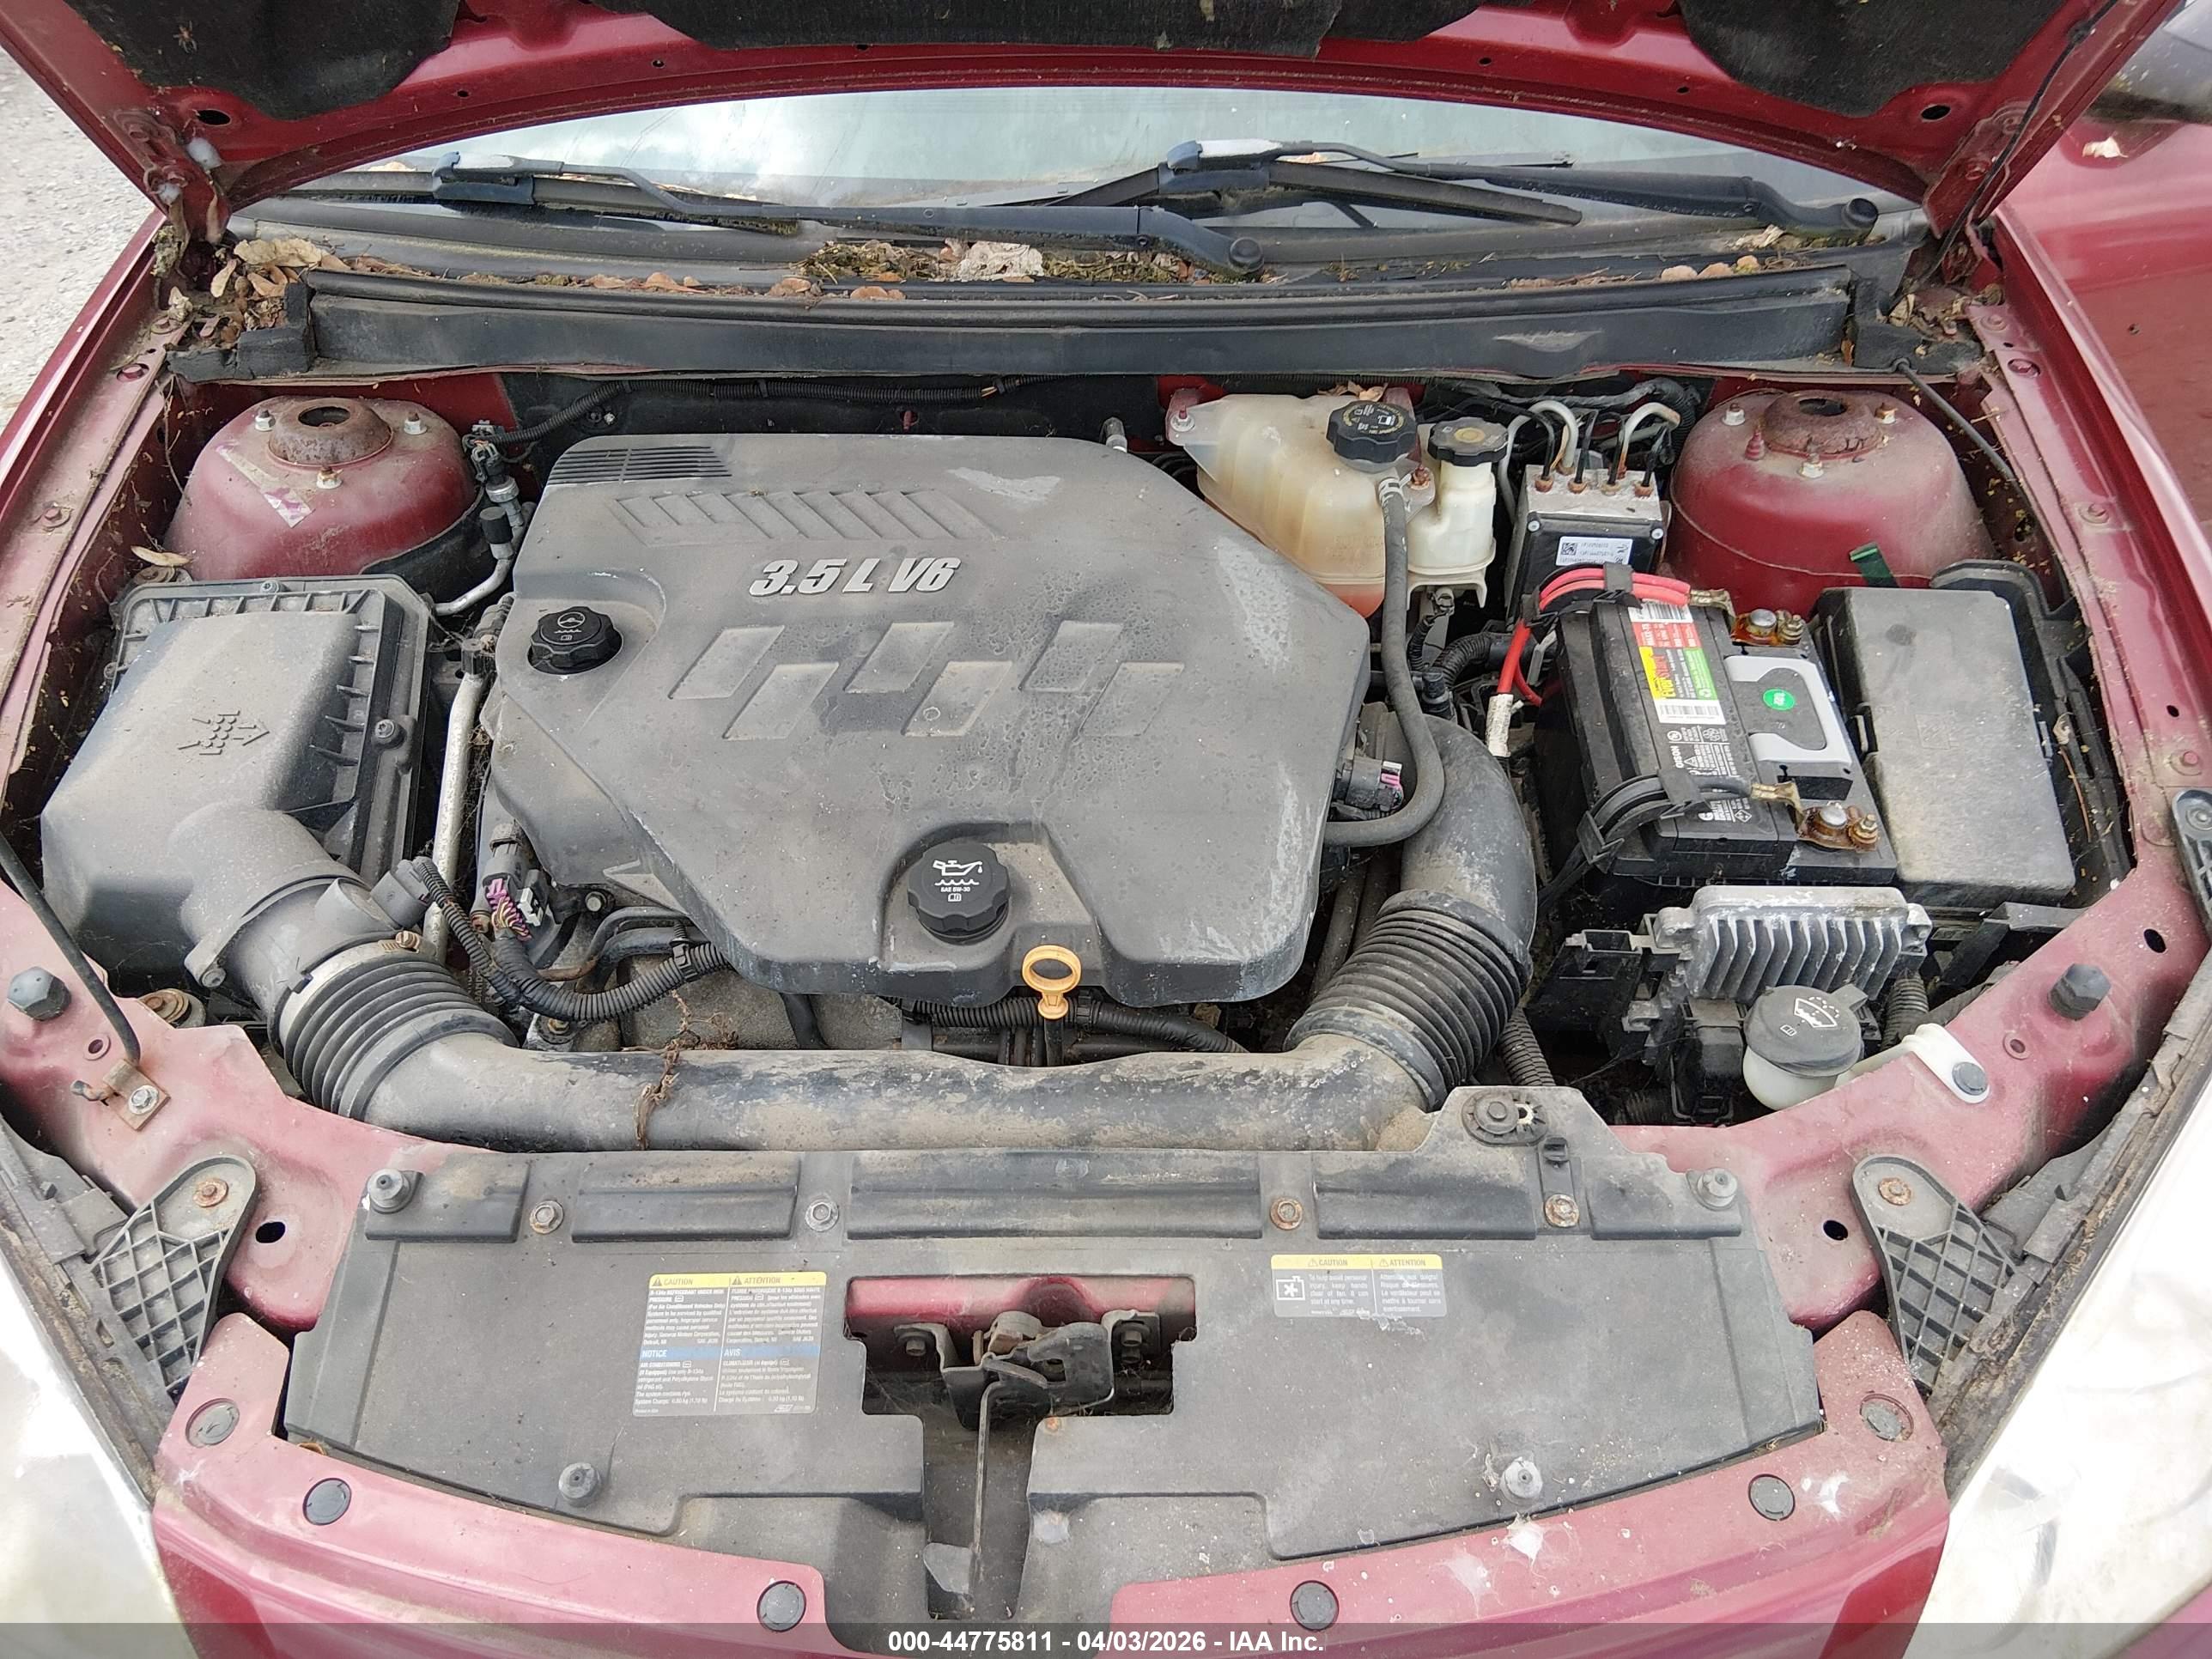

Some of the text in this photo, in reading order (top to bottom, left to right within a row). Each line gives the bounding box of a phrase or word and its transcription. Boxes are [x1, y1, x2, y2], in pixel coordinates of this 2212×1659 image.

[750, 557, 961, 596] 3.5 L V6
[1670, 745, 1685, 769] OISON
[723, 1348, 741, 1357] AVIS
